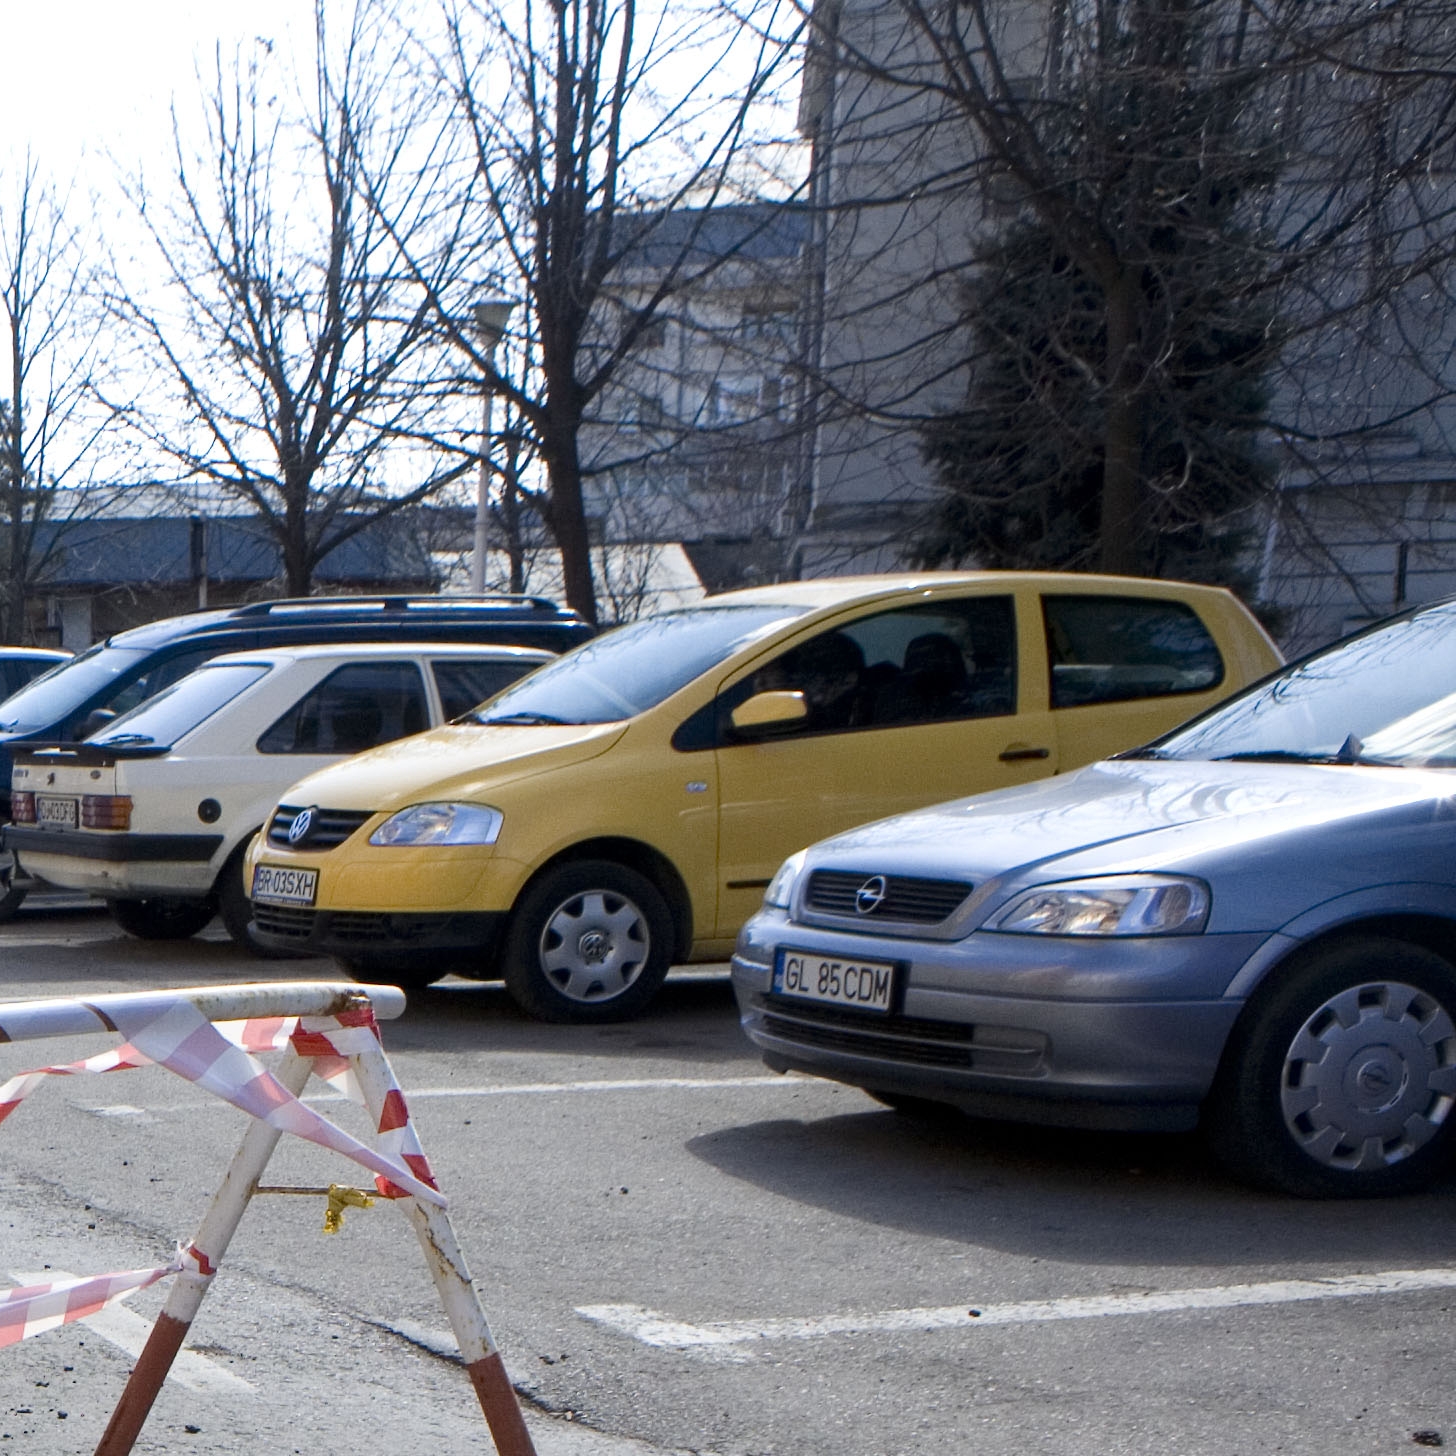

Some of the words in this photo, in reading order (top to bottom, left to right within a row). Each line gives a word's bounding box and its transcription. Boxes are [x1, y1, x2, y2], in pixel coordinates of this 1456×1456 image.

[257, 869, 272, 892] BR
[273, 871, 314, 897] 03SXH
[786, 957, 809, 992] GL
[817, 961, 890, 1004] 85CDM
